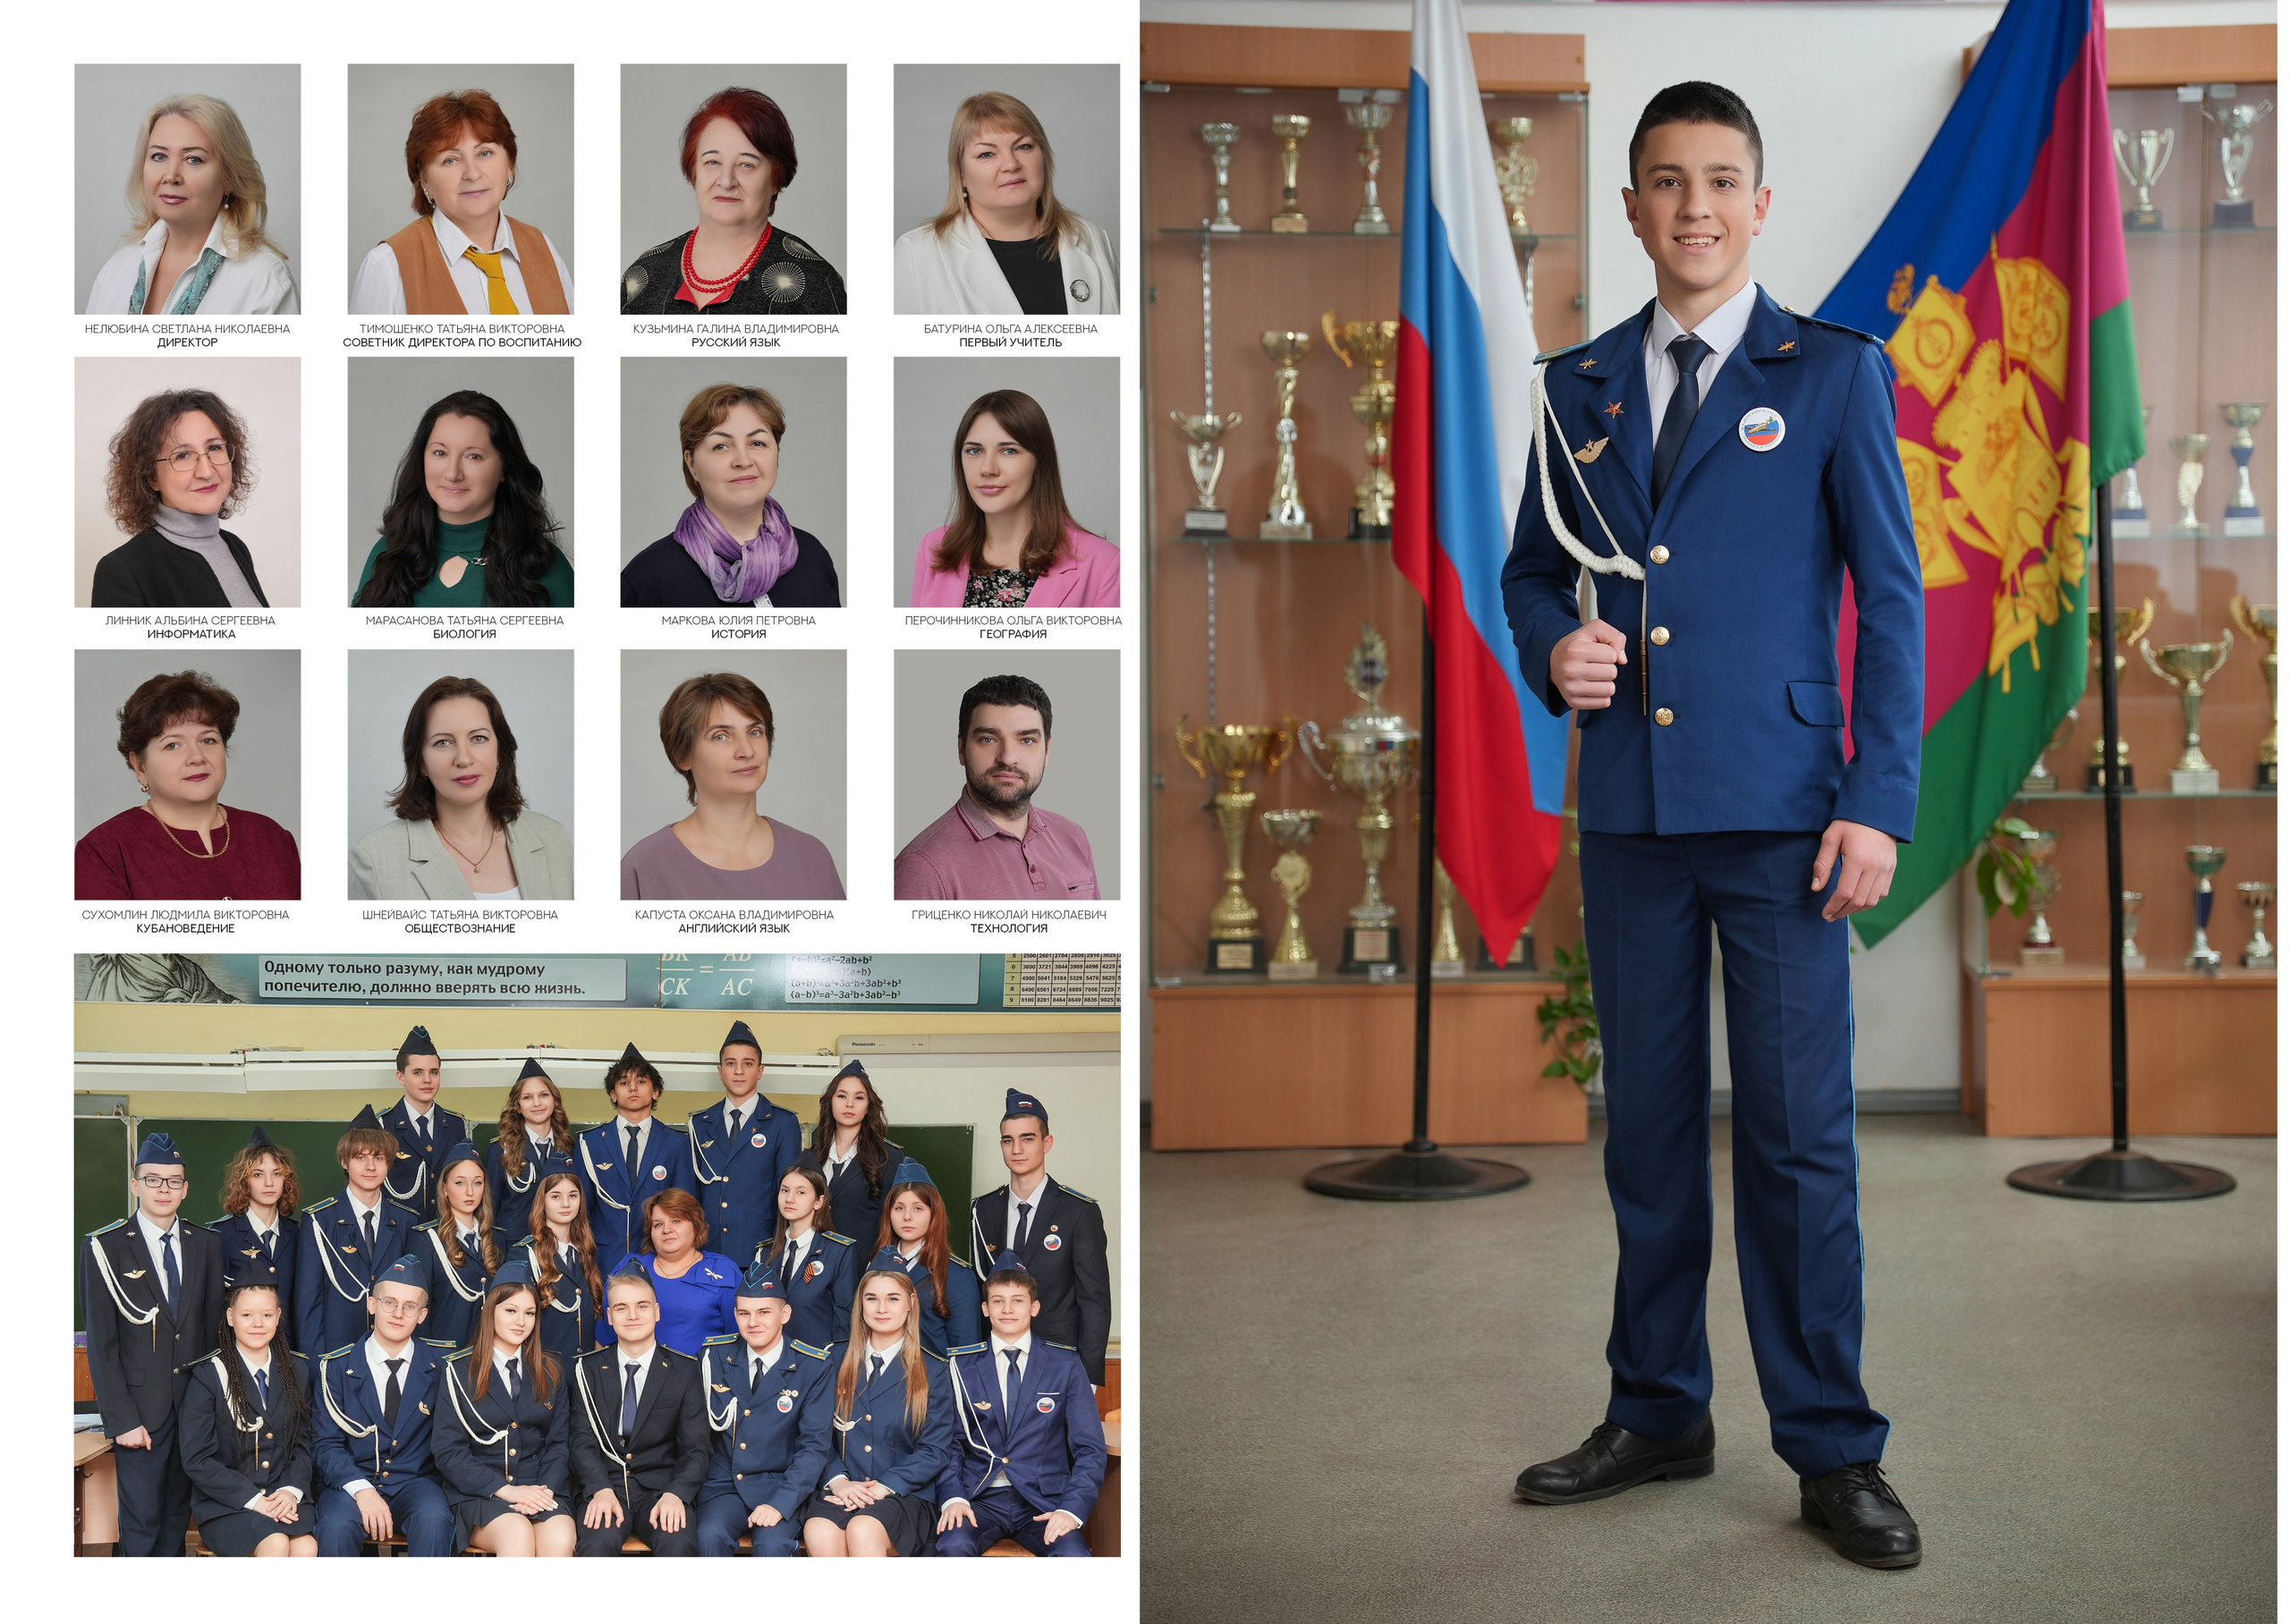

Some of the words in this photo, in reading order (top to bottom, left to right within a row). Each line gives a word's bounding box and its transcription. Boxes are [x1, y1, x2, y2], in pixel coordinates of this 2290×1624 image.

[264, 960, 324, 975] Одному
[327, 963, 382, 974] только
[386, 964, 443, 977] разуму,
[446, 964, 473, 975] как
[477, 965, 545, 977] мудрому
[264, 981, 366, 994] попечителю,
[369, 983, 431, 995] должно
[436, 983, 496, 995] вверять
[500, 984, 530, 994] всю
[534, 984, 586, 994] жизнь.
[658, 977, 691, 995] CK
[720, 977, 753, 995] AC
